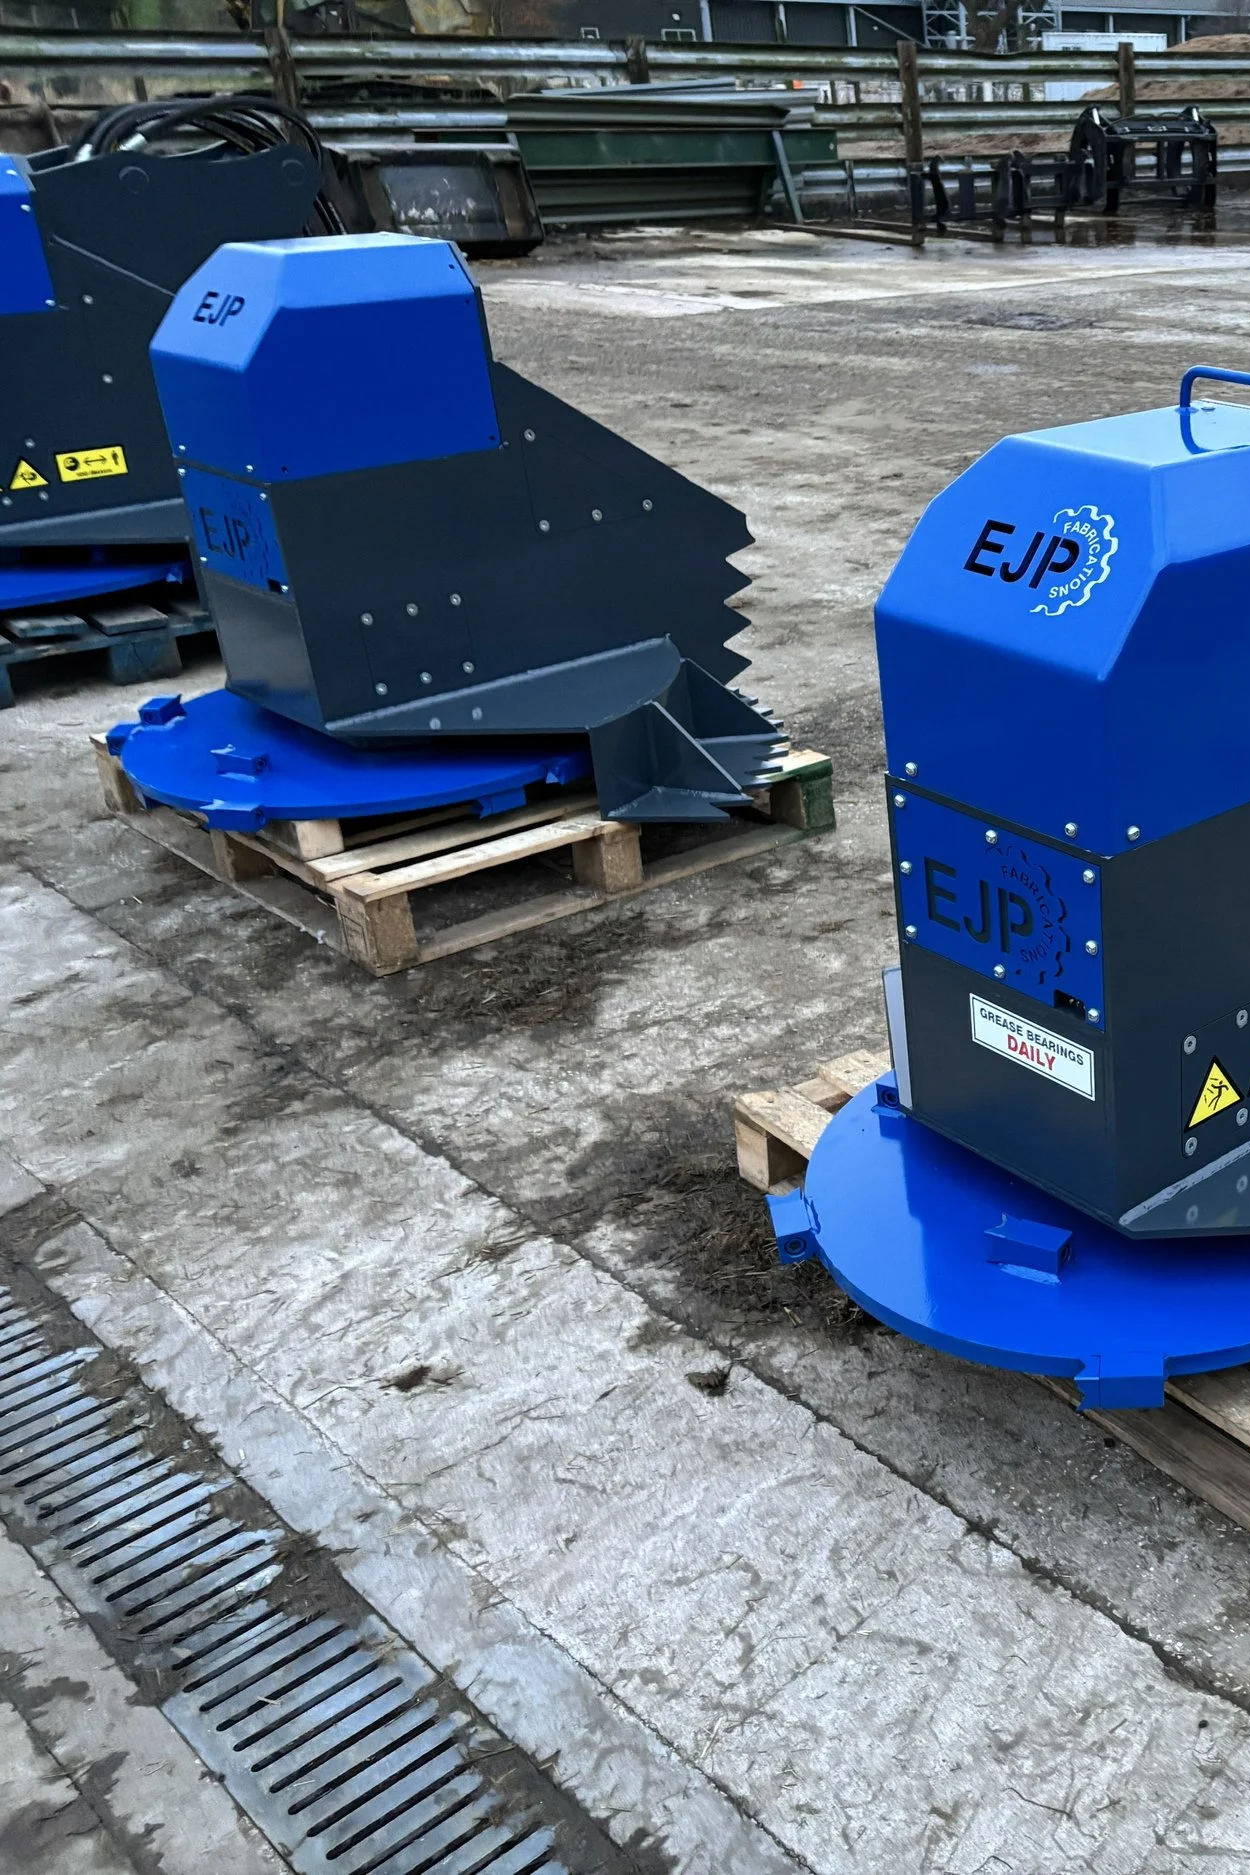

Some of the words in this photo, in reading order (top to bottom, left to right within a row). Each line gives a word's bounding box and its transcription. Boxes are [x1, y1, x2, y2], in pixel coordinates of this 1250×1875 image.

[193, 291, 246, 327] EJP
[199, 507, 250, 561] EJP
[963, 519, 1080, 589] EJP
[1049, 521, 1100, 598] FABRICATIONS
[924, 856, 1034, 954] EJP
[1001, 865, 1053, 963] FABRICATIONS
[979, 1007, 1024, 1037] GREASE
[1026, 1030, 1084, 1066] BEARINGS
[1007, 1034, 1056, 1071] DAILY
